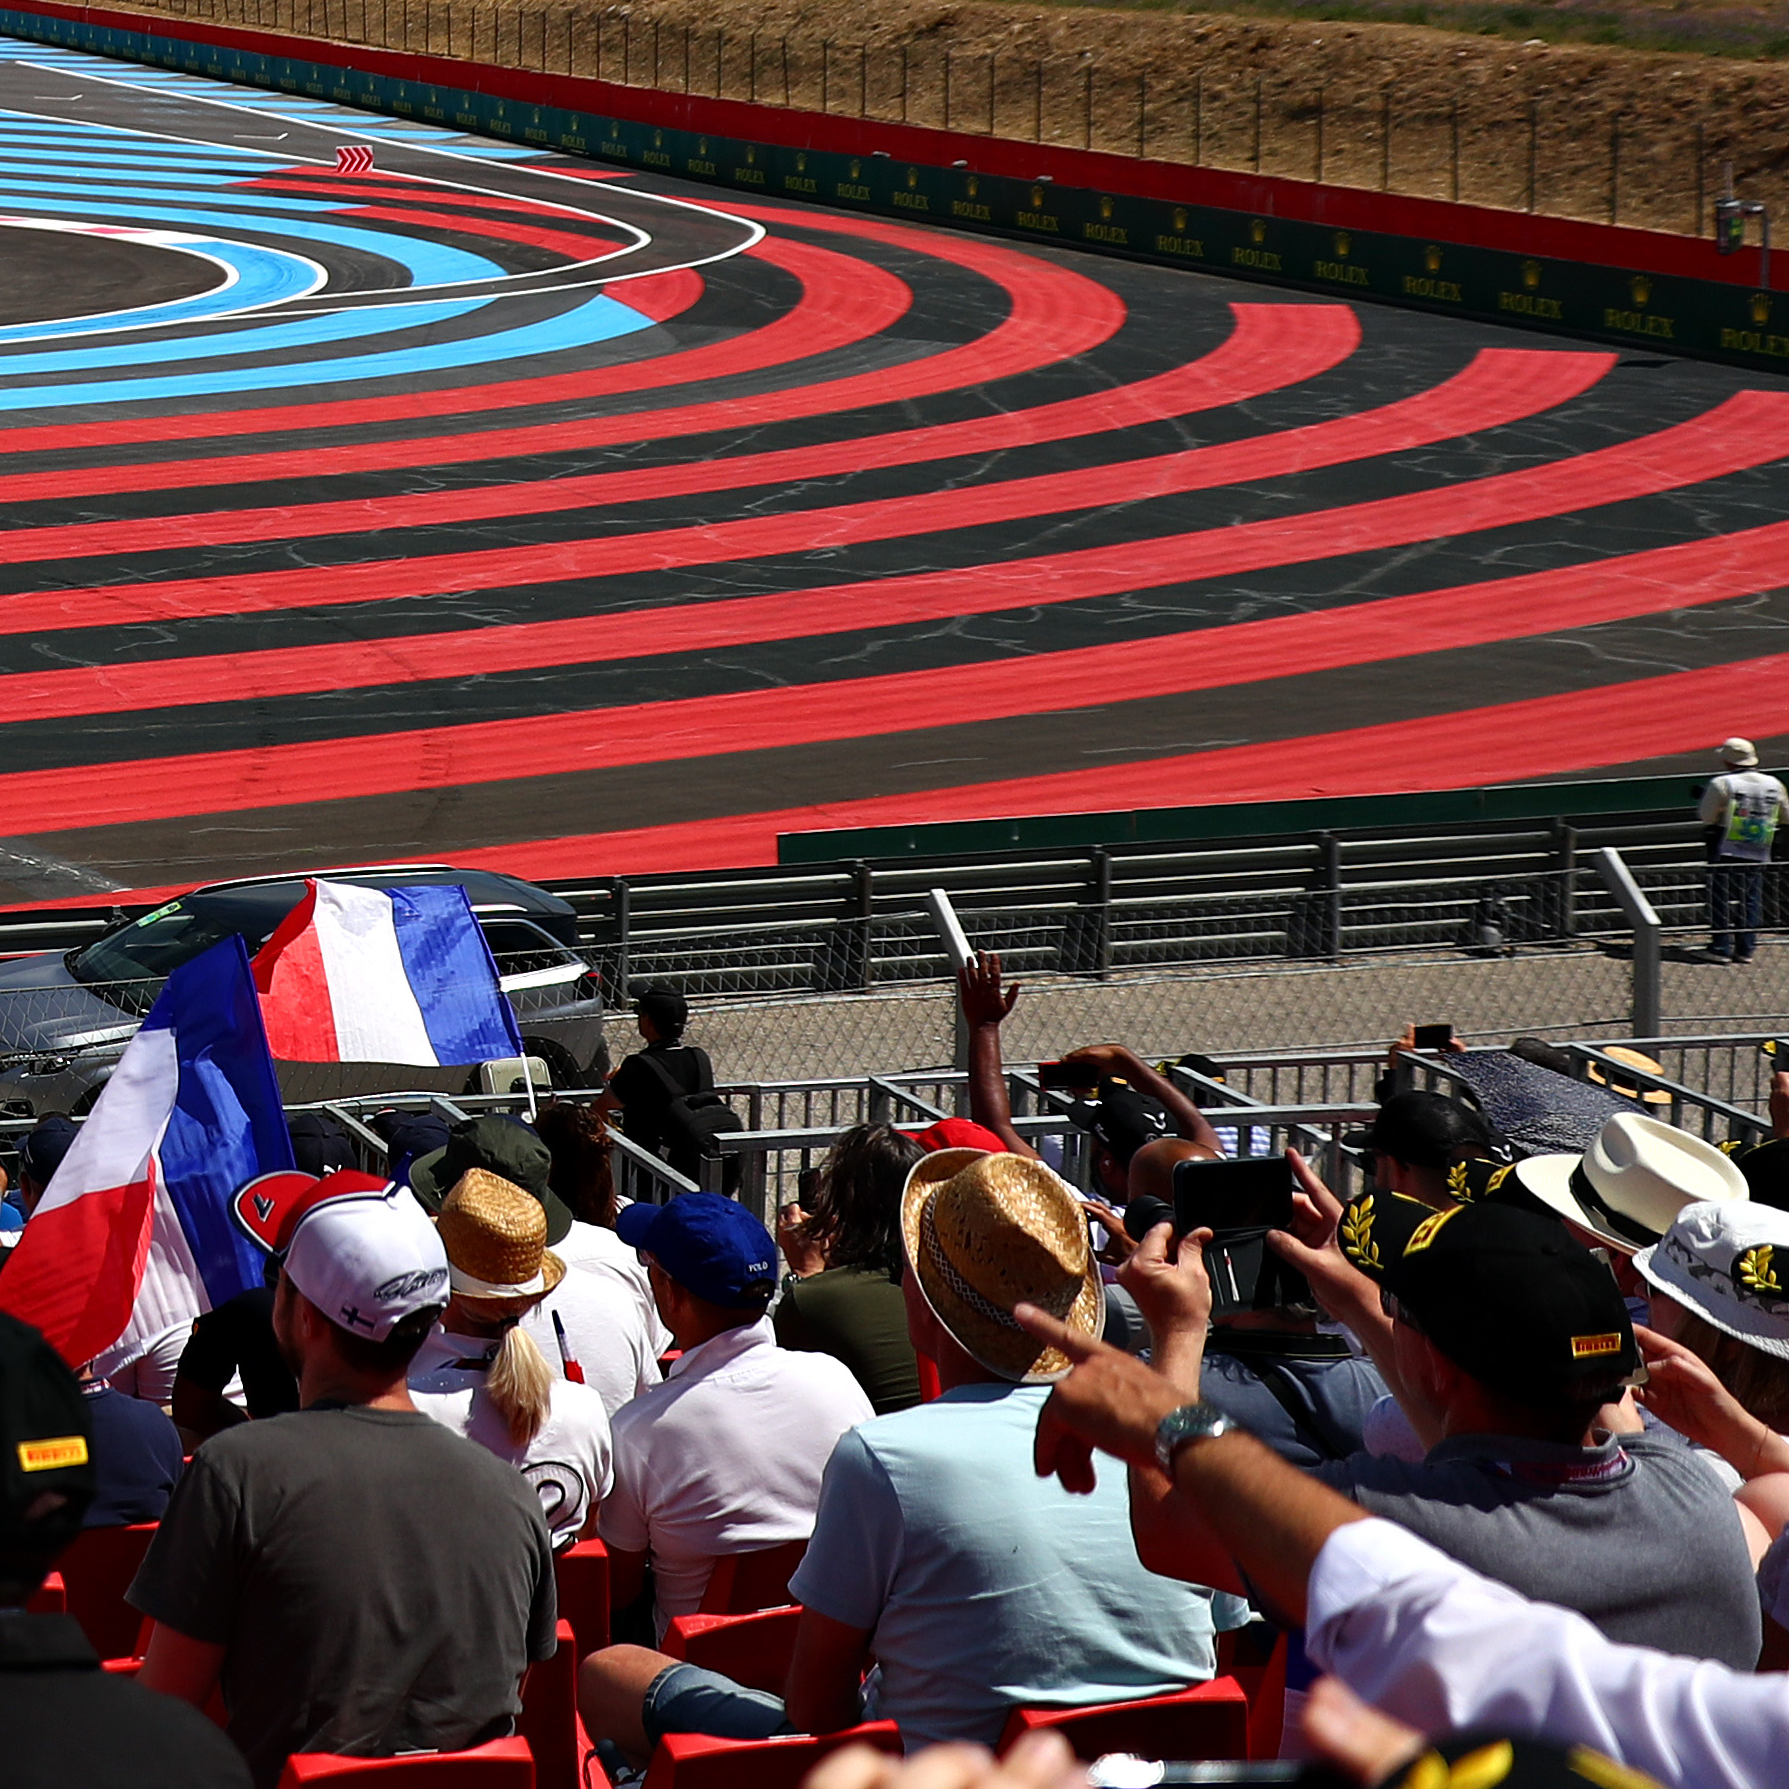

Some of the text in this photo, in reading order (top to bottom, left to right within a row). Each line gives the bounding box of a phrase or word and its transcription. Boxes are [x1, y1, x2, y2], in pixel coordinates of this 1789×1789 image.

[688, 159, 716, 176] ROLEX
[735, 168, 765, 184] ROLEX
[785, 175, 817, 193] ROLEX
[837, 183, 870, 200] ROLEX
[893, 192, 930, 210] ROLEX
[952, 201, 991, 221] ROLEX
[1018, 211, 1059, 232] ROLEX
[1085, 222, 1128, 245] ROLEX
[1157, 235, 1203, 257] ROLEX
[1232, 247, 1282, 272] ROLEX
[1315, 260, 1370, 286] ROLEX
[1403, 277, 1462, 303] ROLEX
[1499, 292, 1563, 320] ROLEX
[1605, 308, 1674, 339] ROLEX
